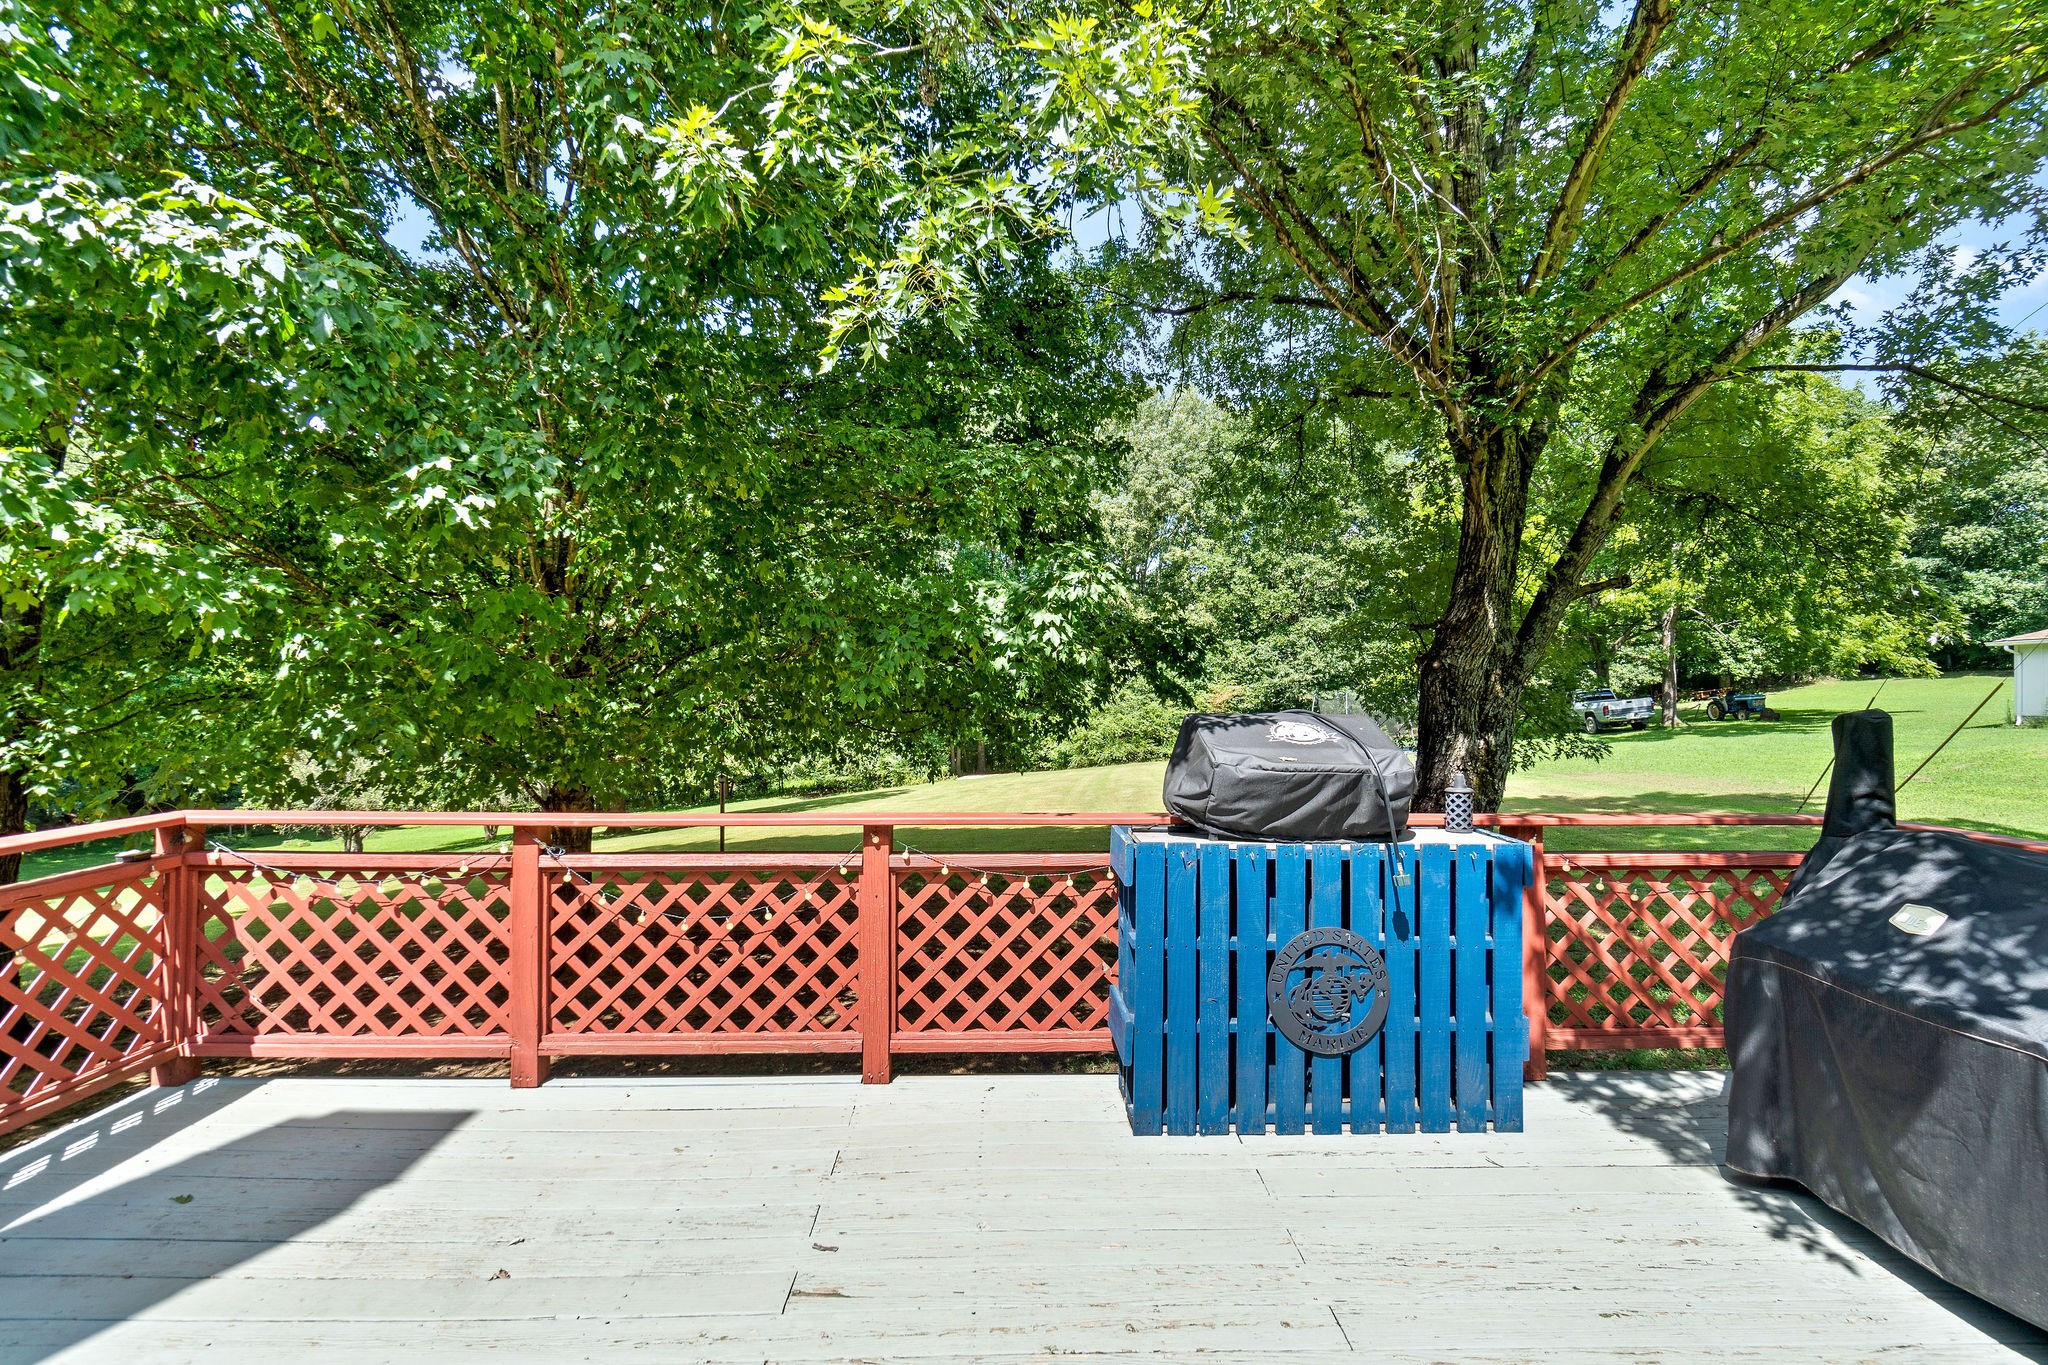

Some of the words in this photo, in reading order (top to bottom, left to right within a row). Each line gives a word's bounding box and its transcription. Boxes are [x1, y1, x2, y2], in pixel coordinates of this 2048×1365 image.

[1271, 930, 1325, 984] UNITED
[1332, 930, 1387, 981] STATES
[1297, 1026, 1369, 1050] MARINE
